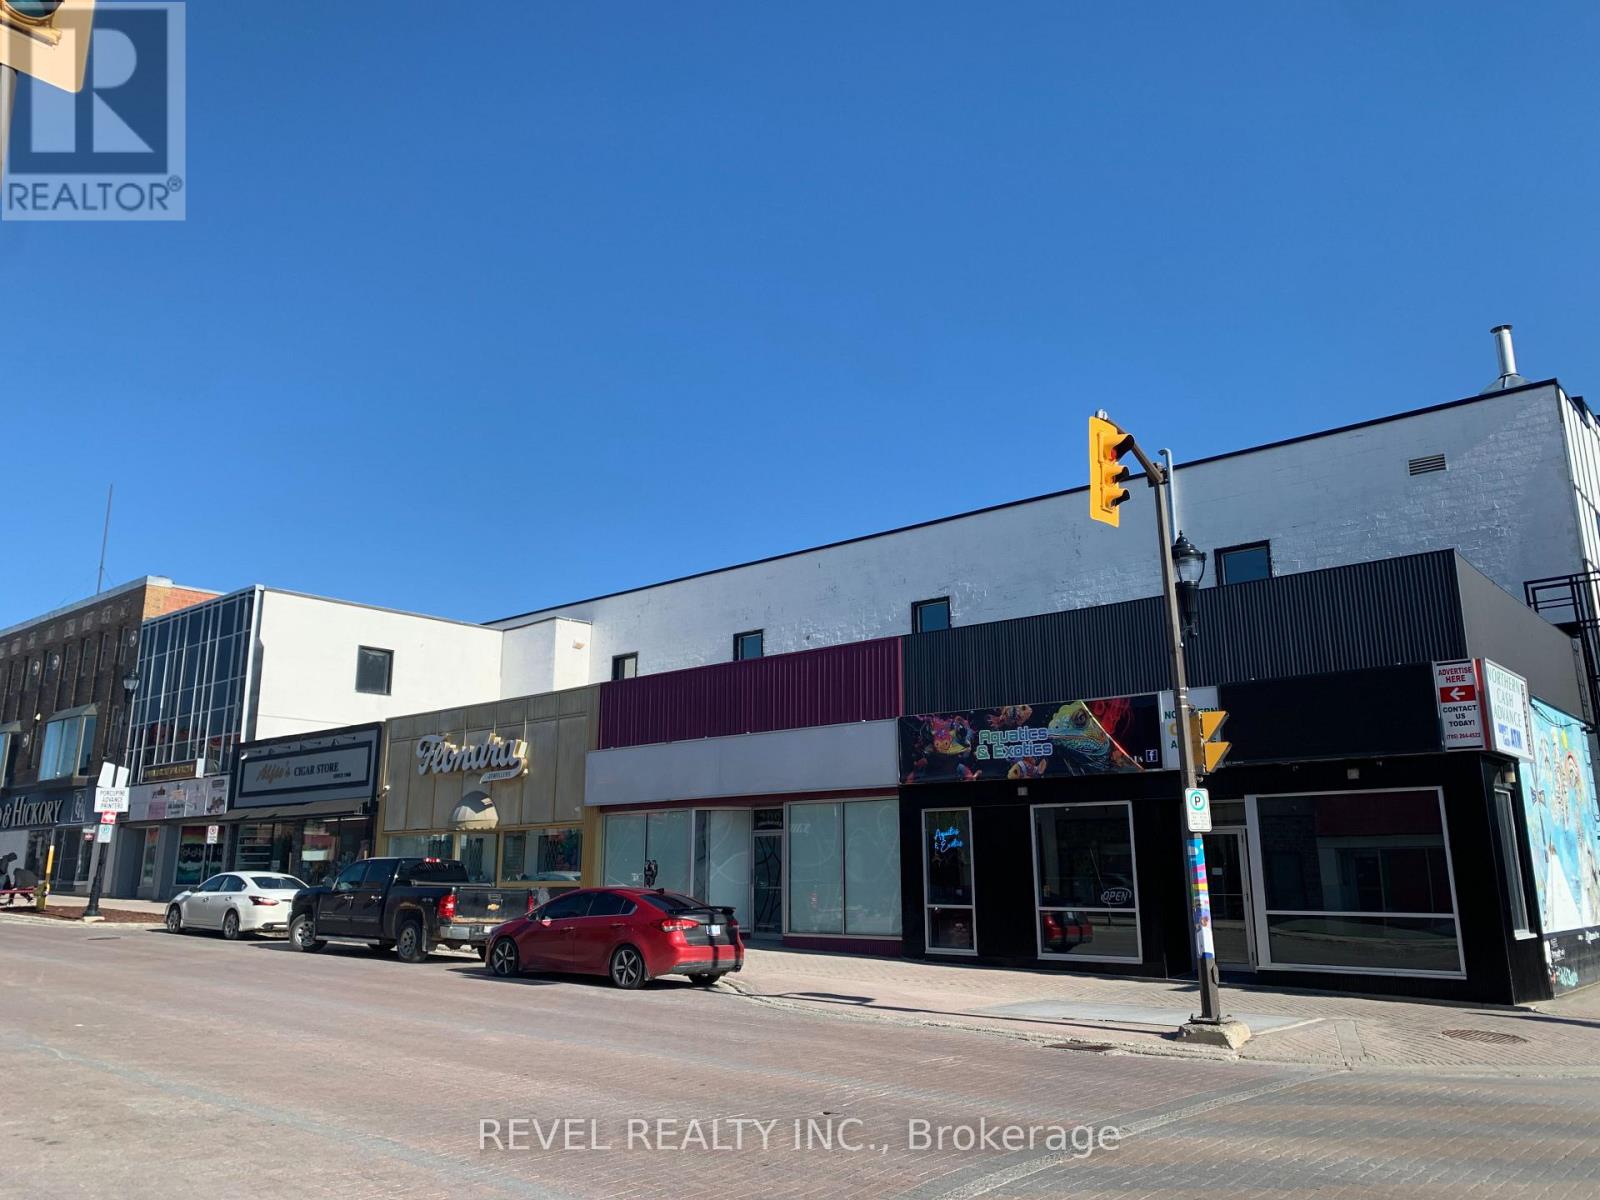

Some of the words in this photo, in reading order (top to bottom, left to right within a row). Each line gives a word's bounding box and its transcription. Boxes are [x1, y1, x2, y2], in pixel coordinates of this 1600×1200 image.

[1439, 666, 1473, 676] ADVERTISE
[1445, 674, 1466, 683] HERE
[1486, 667, 1521, 695] NORTHERN
[1496, 687, 1514, 708] CASH
[1442, 705, 1478, 713] CONTACT
[1493, 704, 1522, 728] ADVANCE
[1448, 719, 1475, 728] TODAY!
[978, 726, 1049, 746] Aquatics
[976, 745, 990, 760] &
[992, 741, 1053, 760] Exotics
[293, 764, 315, 777] CIGAR
[316, 761, 340, 775] STORE
[2, 803, 12, 828] &
[11, 796, 64, 828] HICKORY
[1103, 890, 1129, 902] OPEN
